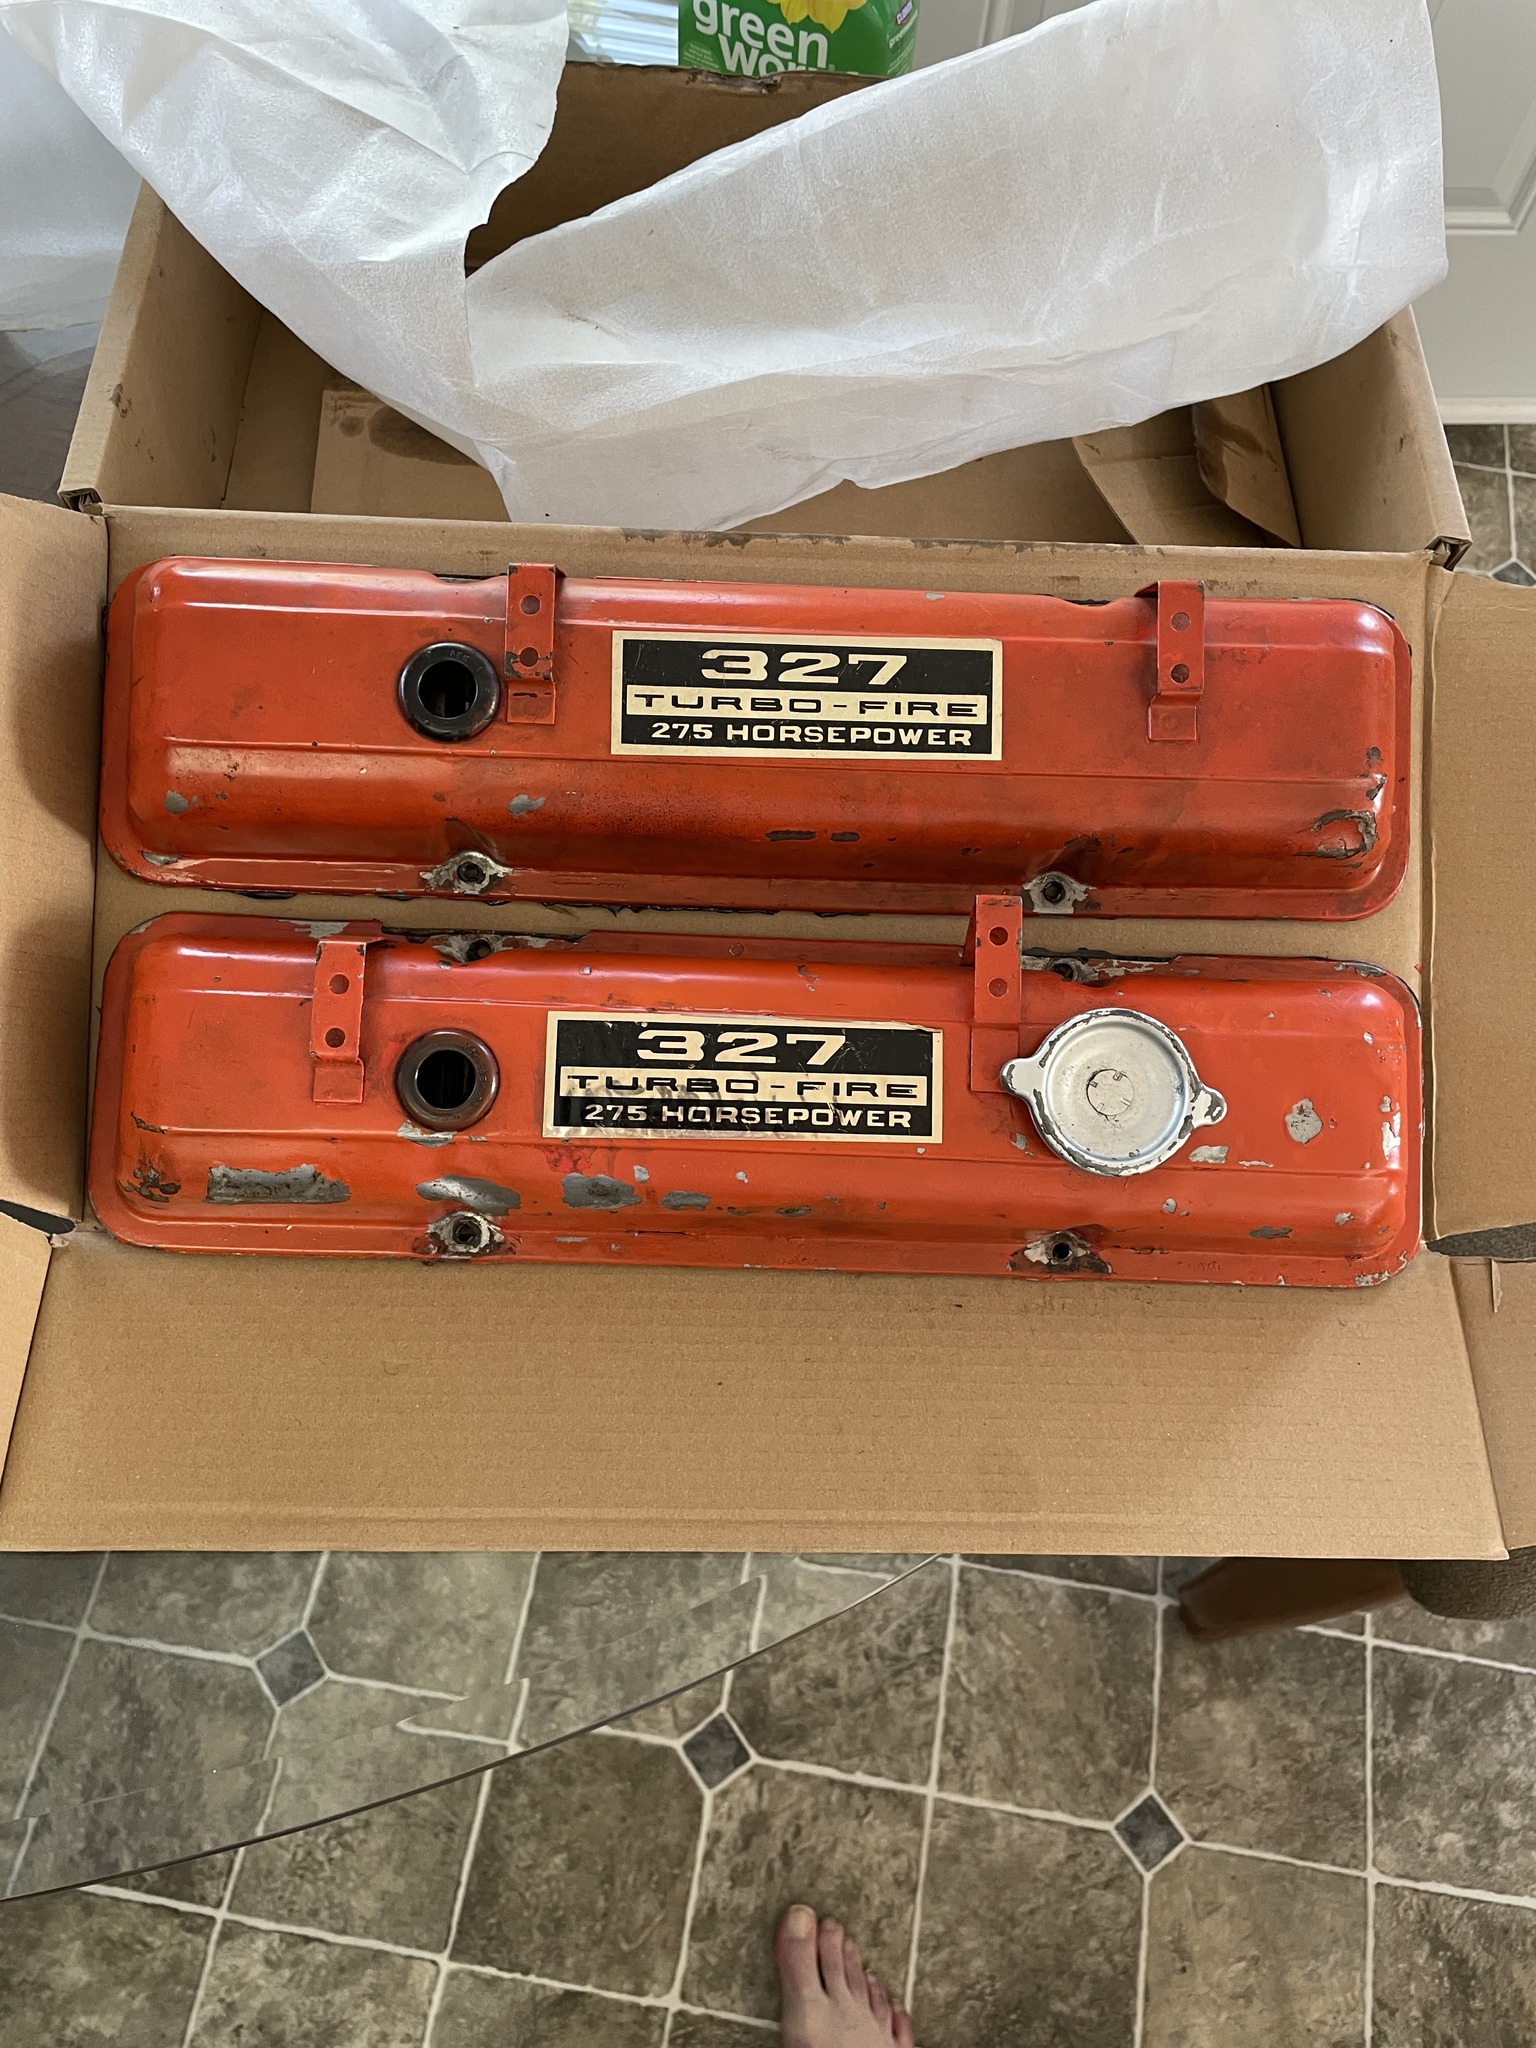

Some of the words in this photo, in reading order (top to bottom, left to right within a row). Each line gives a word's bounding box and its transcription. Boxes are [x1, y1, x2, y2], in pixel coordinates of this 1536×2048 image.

[693, 0, 828, 69] green
[701, 649, 908, 686] 327
[634, 693, 979, 718] TURBO-FIRE
[651, 722, 713, 741] 275
[726, 723, 972, 746] HORSEPOWER
[637, 1029, 846, 1066] 327
[567, 1074, 918, 1099] TURBO-FIRE
[585, 1104, 648, 1121] 275
[662, 1105, 911, 1128] HORSEPOWER
